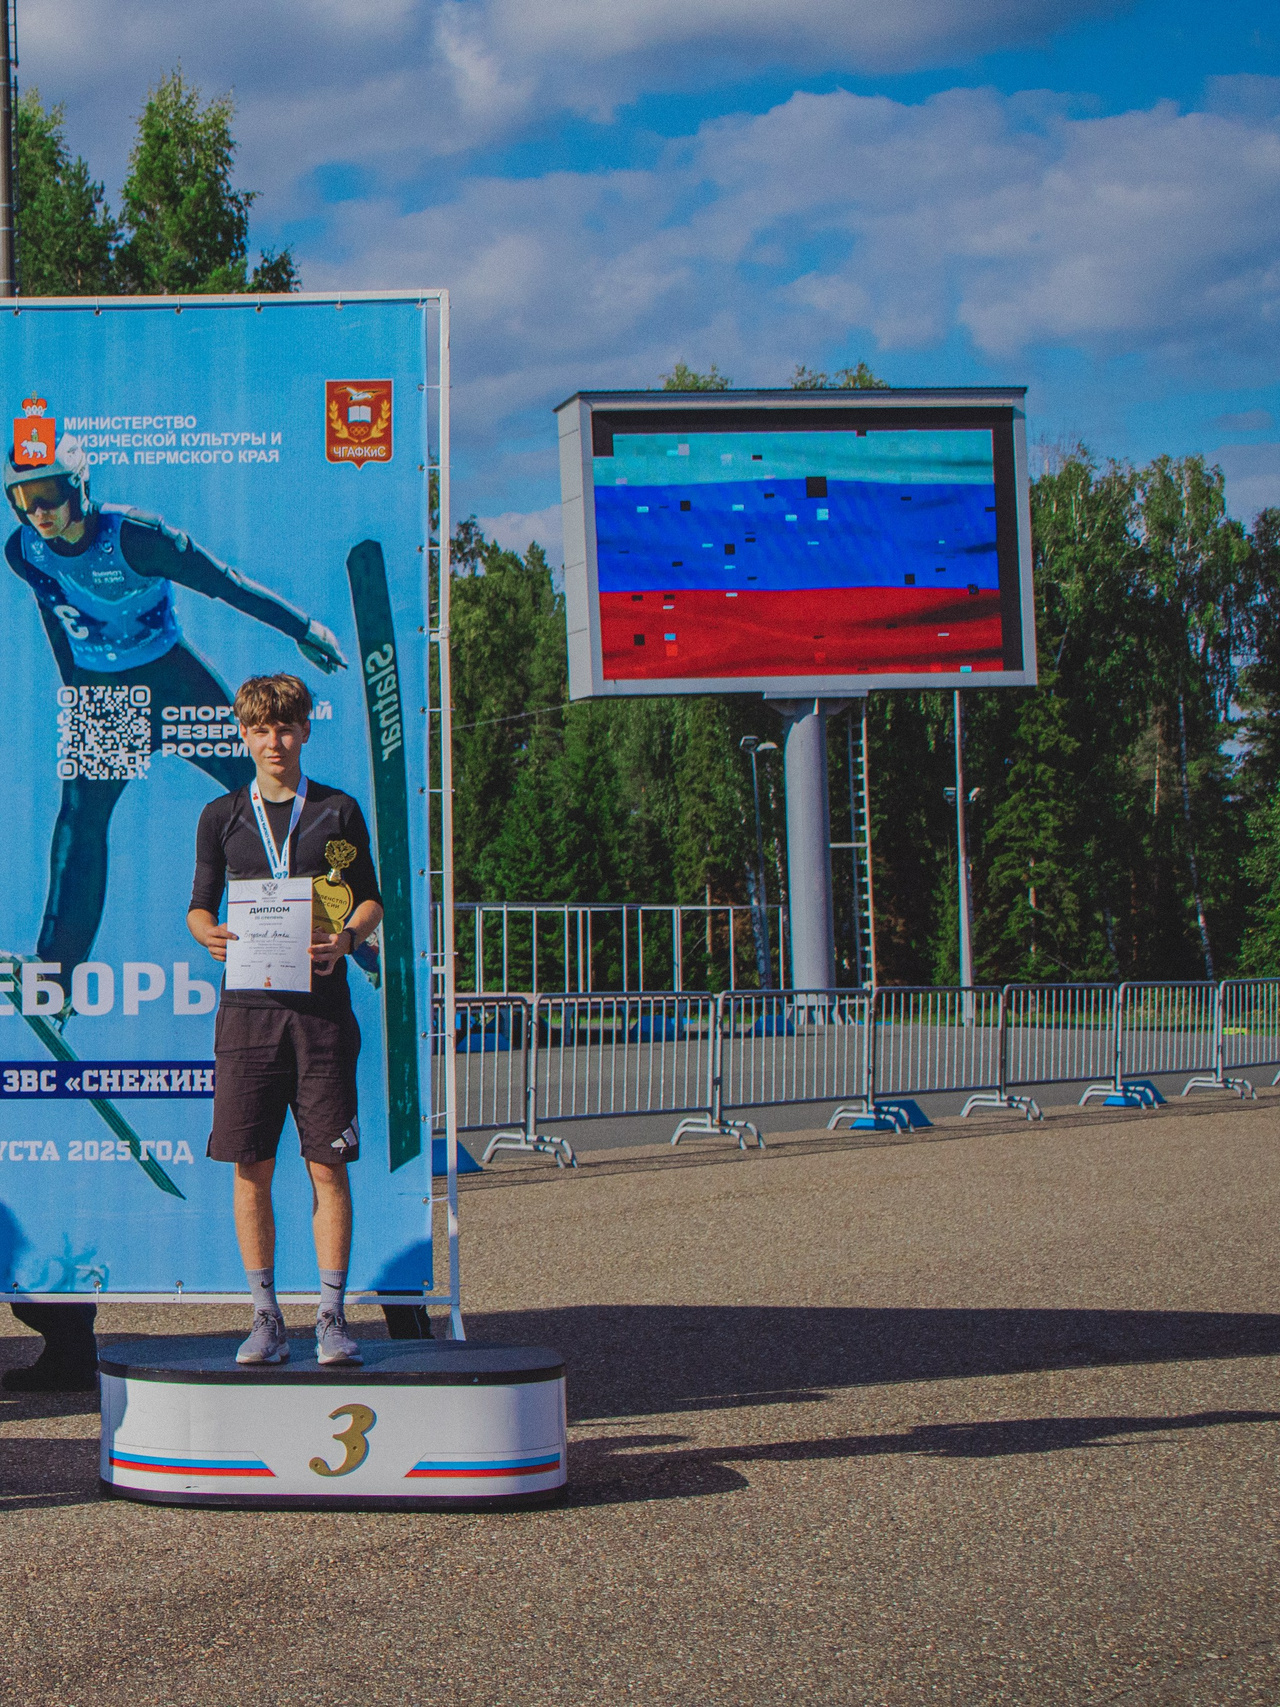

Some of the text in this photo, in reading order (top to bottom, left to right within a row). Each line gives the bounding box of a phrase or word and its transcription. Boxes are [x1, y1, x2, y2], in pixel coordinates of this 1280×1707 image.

[63, 415, 197, 430] МИНИСТЕРСТВО
[76, 431, 282, 448] ИЗИЧЕСКОЙ КУЛЬТУРЫ И
[86, 450, 279, 465] ОРТА ПЕРМСКОГО КРАЯ
[333, 446, 386, 457] ЧГАФКиС
[161, 724, 243, 740] РЕЗЕР
[161, 742, 252, 758] РОССИ
[249, 906, 290, 914] ДИПЛОМ
[3, 1069, 57, 1093] ЗВС
[65, 1069, 215, 1093] «СНЕЖИН
[68, 1140, 132, 1162] 2025
[139, 1140, 194, 1164] ГОД
[308, 1403, 377, 1477] 3
